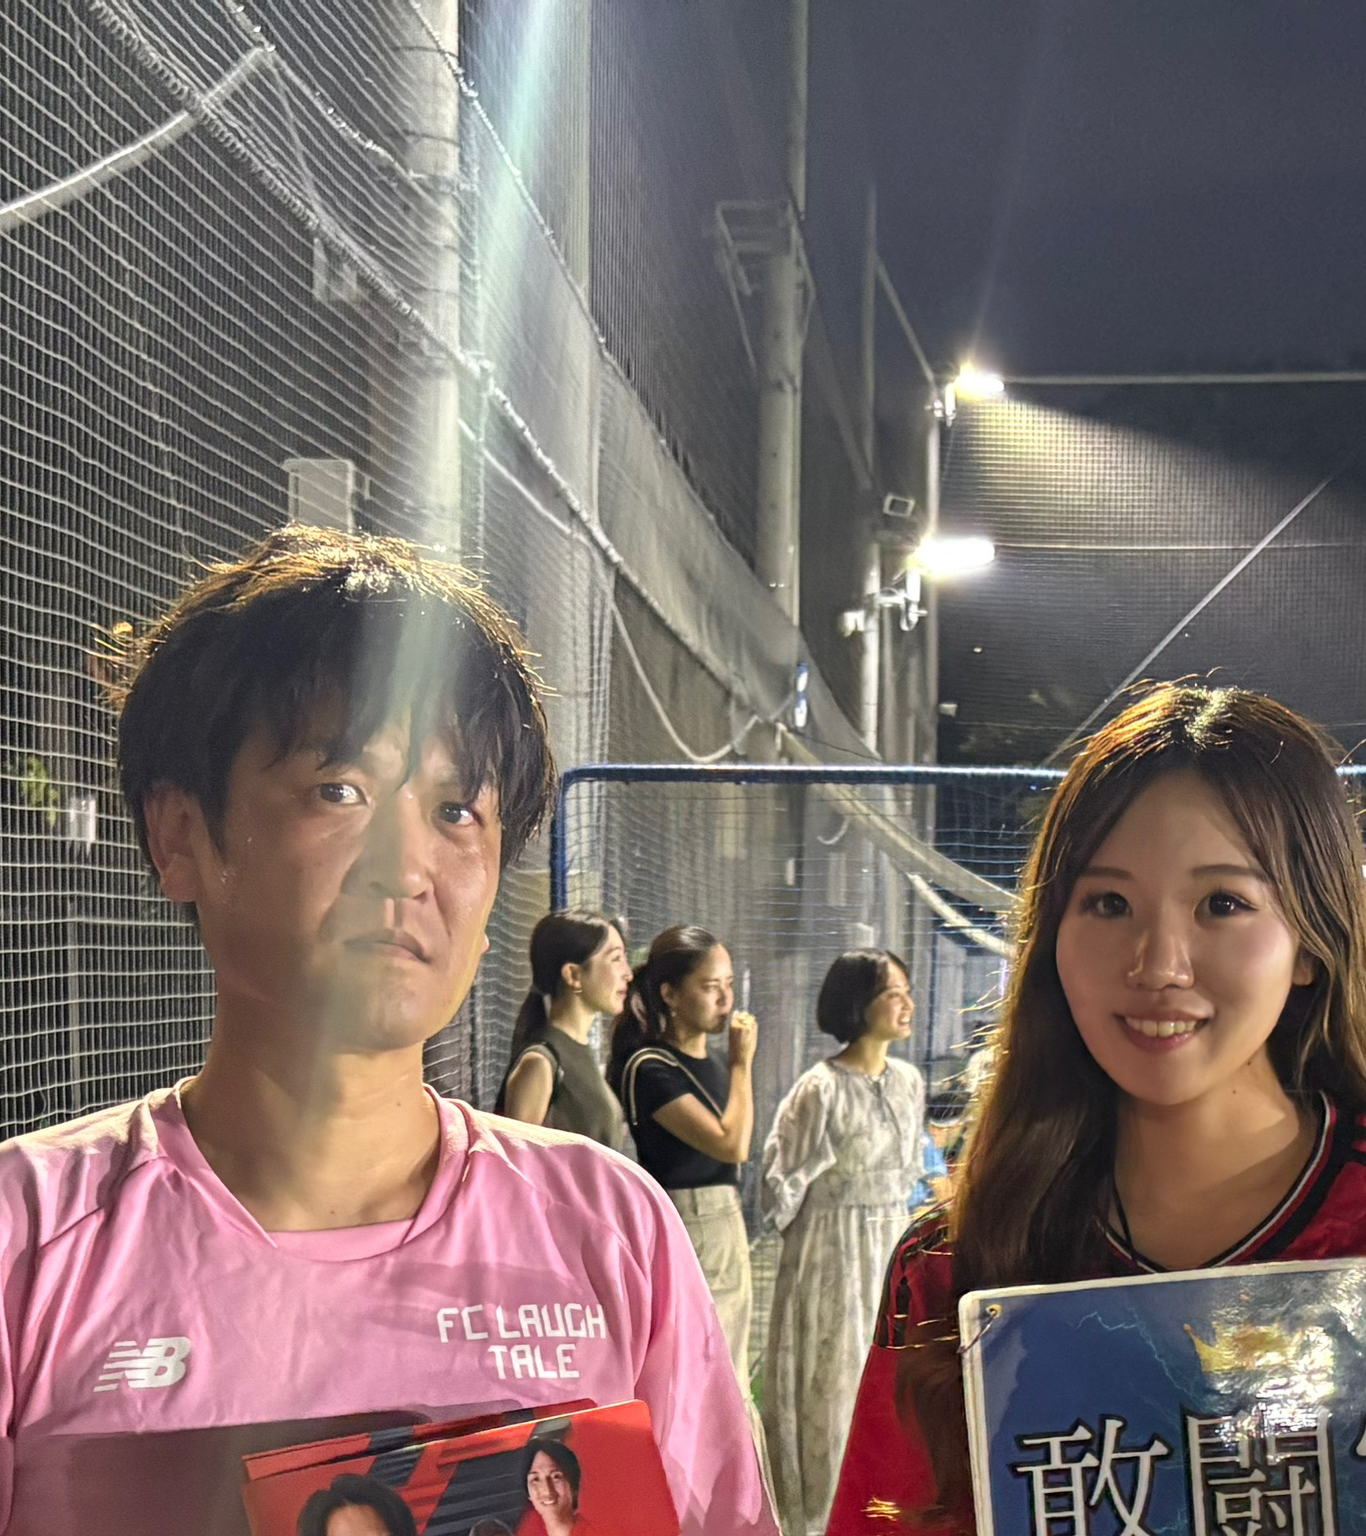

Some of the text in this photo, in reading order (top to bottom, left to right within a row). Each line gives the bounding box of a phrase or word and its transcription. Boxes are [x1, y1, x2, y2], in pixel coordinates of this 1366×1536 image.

[437, 1303, 607, 1343] FC LAUGH
[487, 1343, 580, 1380] TALE
